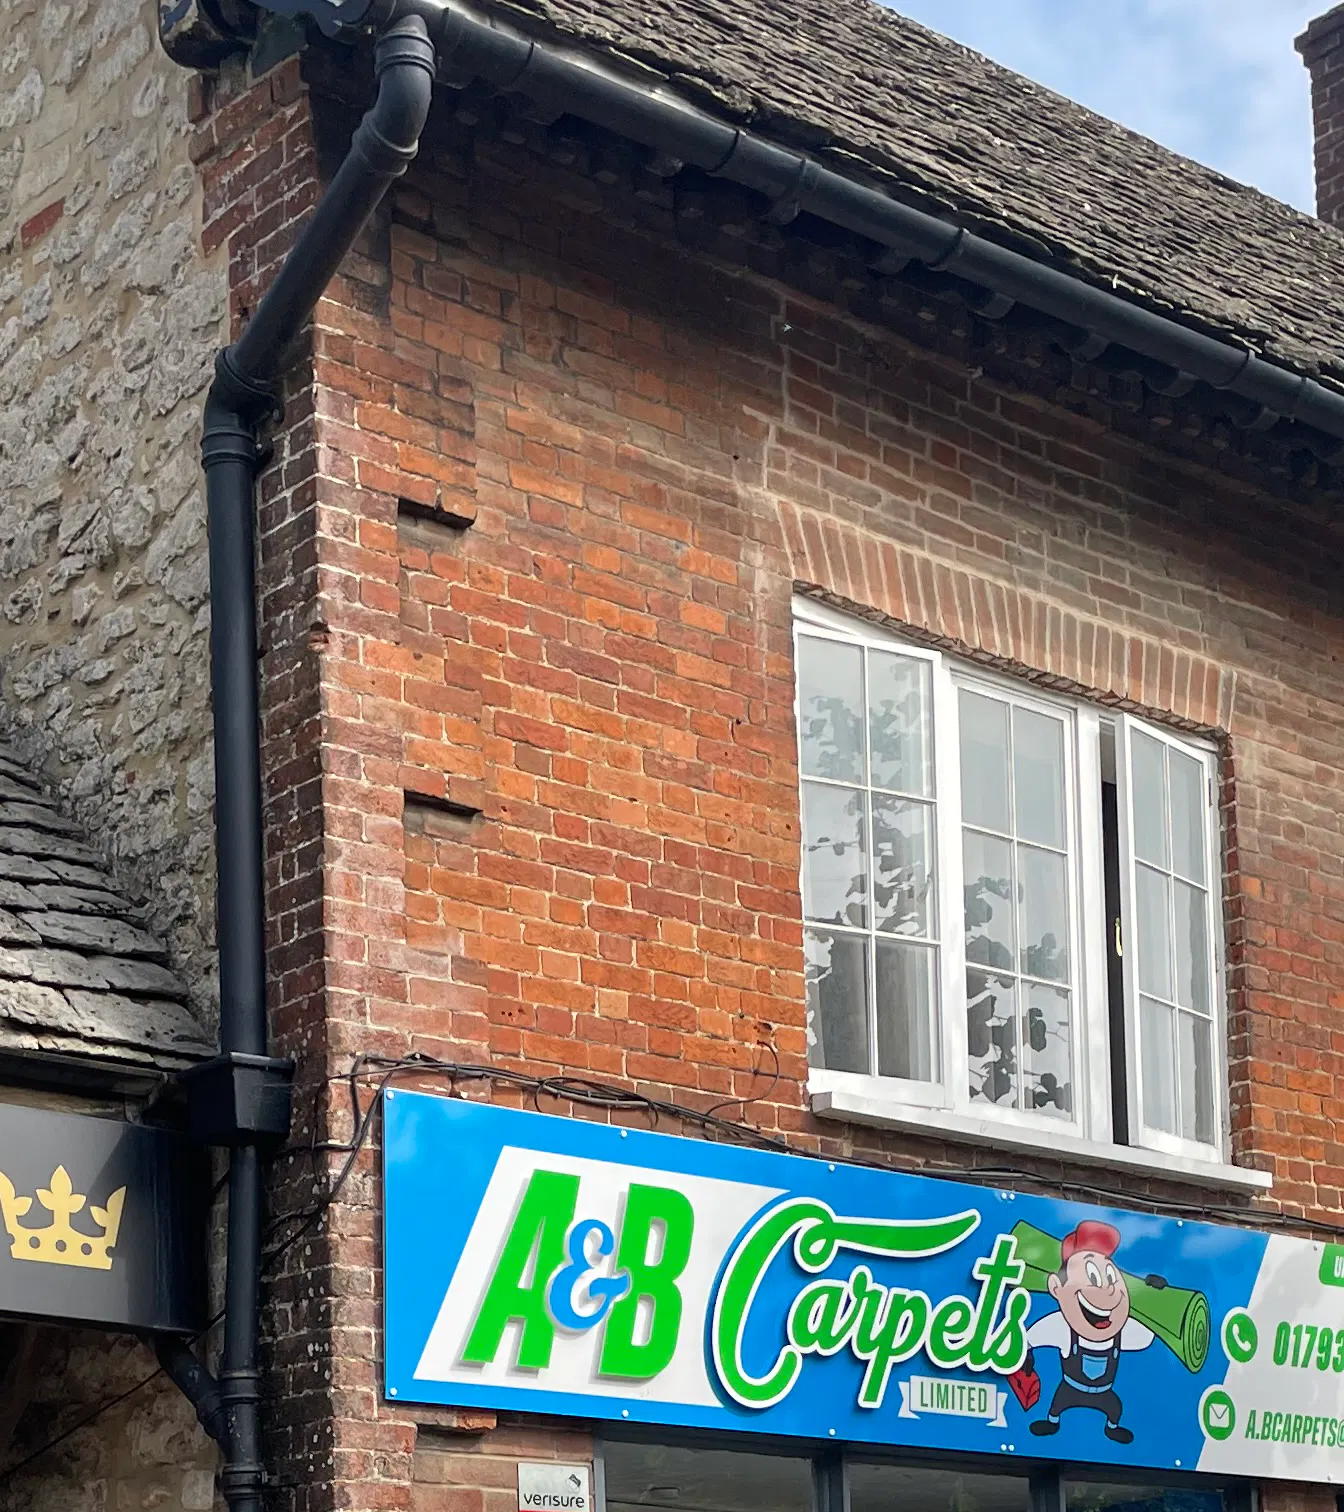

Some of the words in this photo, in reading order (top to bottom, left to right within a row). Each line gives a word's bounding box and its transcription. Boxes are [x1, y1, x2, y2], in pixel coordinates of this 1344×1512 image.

[713, 1197, 1031, 1408] Carpets
[920, 1381, 988, 1413] LIMITED
[524, 1493, 585, 1508] verisure
